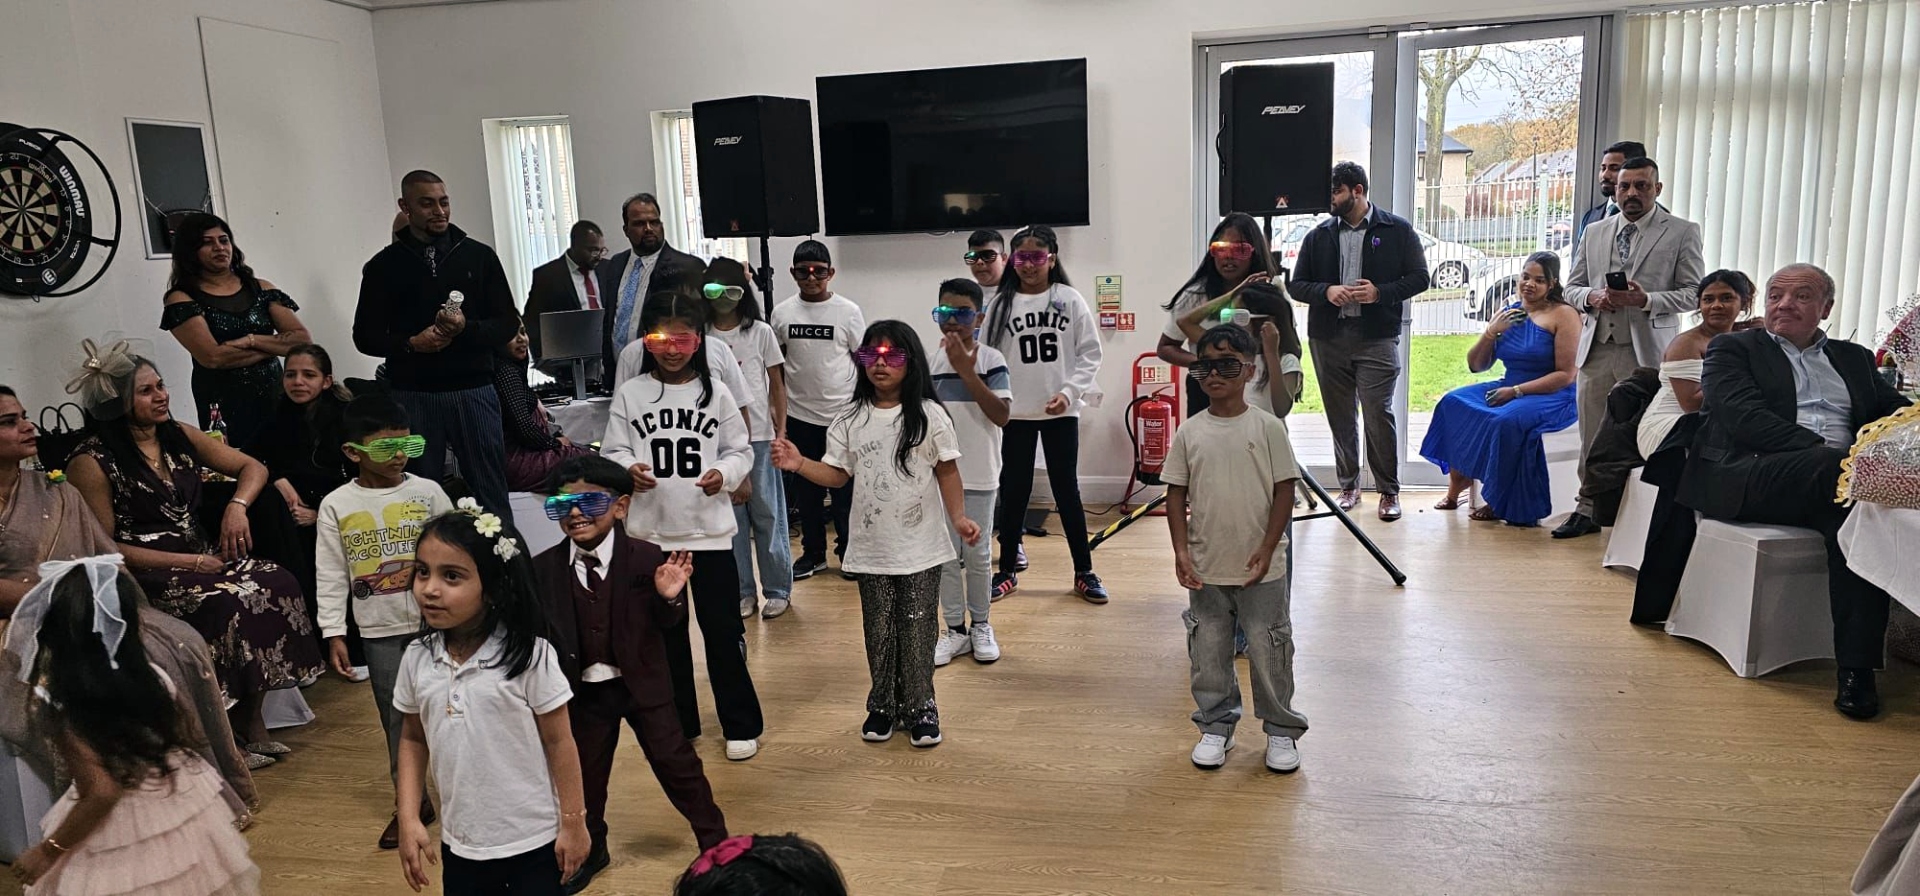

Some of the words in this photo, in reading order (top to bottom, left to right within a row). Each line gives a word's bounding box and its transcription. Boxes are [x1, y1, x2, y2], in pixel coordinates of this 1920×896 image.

[1261, 104, 1306, 115] PEAVEY
[59, 165, 85, 218] WINMAU
[791, 327, 831, 337] NICCE
[1005, 311, 1070, 337] ICONIC
[1019, 332, 1058, 364] 06
[631, 408, 719, 439] ICONIC
[650, 437, 702, 478] 06
[346, 540, 416, 562] MCQUEE
